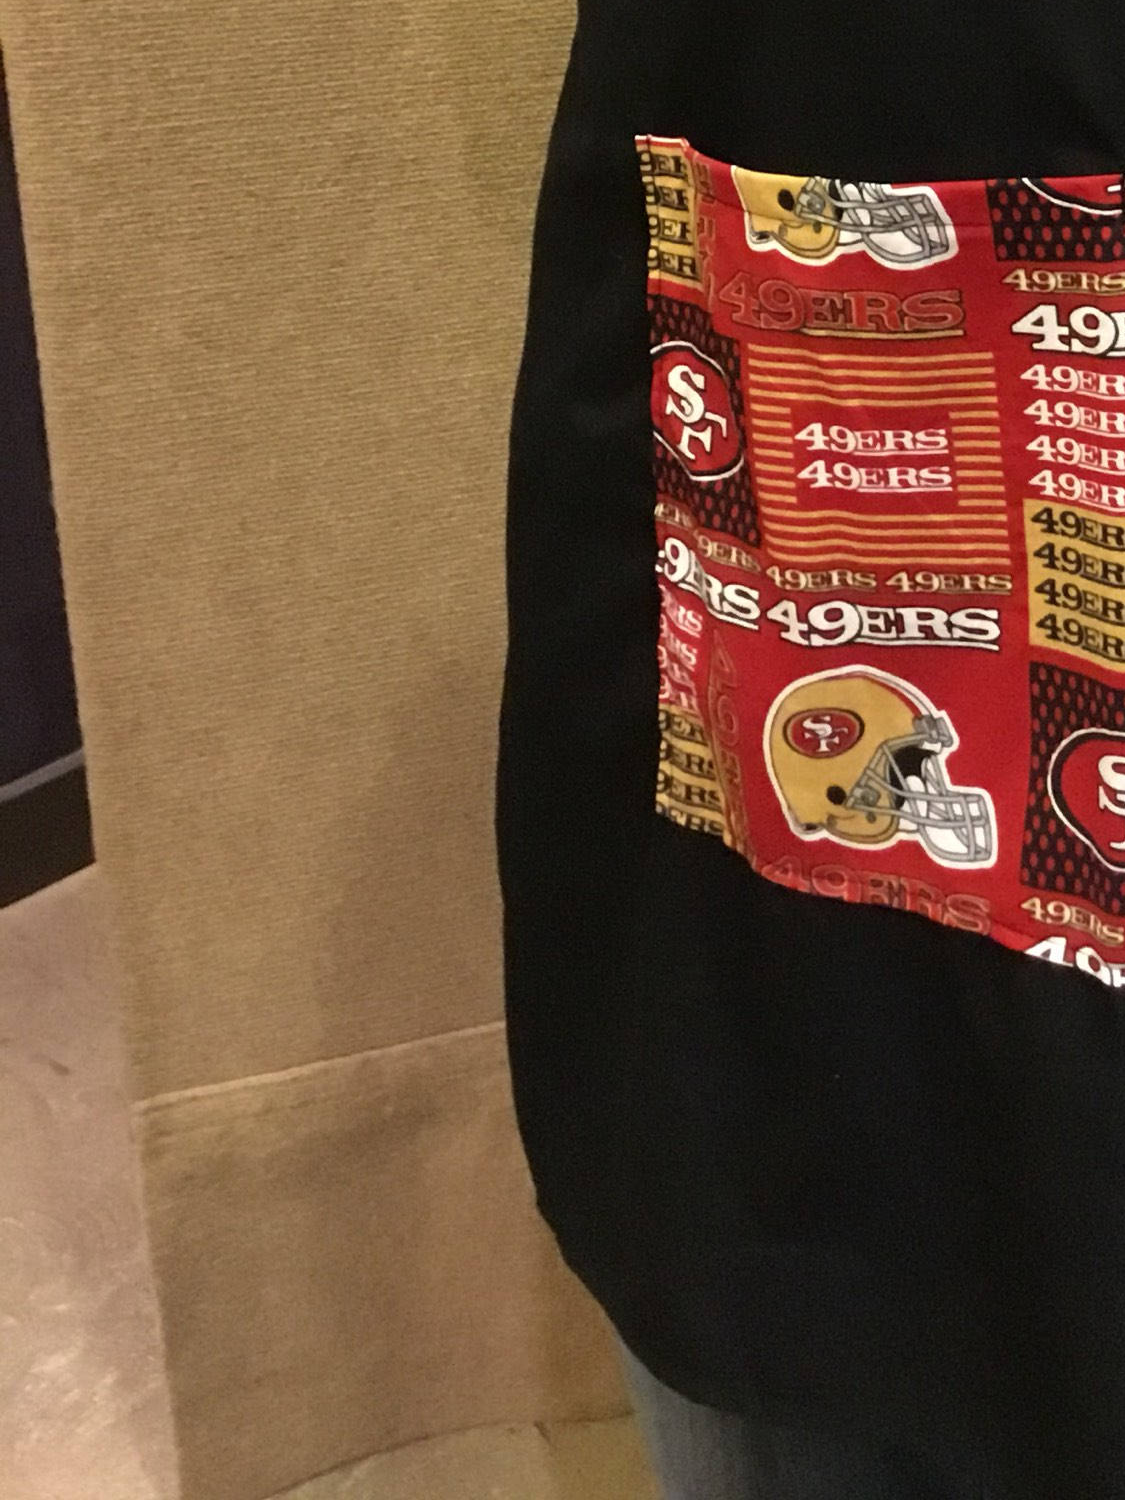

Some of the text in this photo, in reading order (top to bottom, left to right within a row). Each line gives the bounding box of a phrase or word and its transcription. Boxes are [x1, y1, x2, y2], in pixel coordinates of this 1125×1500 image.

[719, 271, 966, 340] 49ERS
[794, 422, 949, 456] 49ERS
[797, 460, 953, 493] 49ERS
[765, 565, 877, 592] 49ERS
[886, 570, 1013, 595] 49ERS
[766, 600, 1001, 651] 49ERS
[1021, 896, 1125, 946] 49ERS
